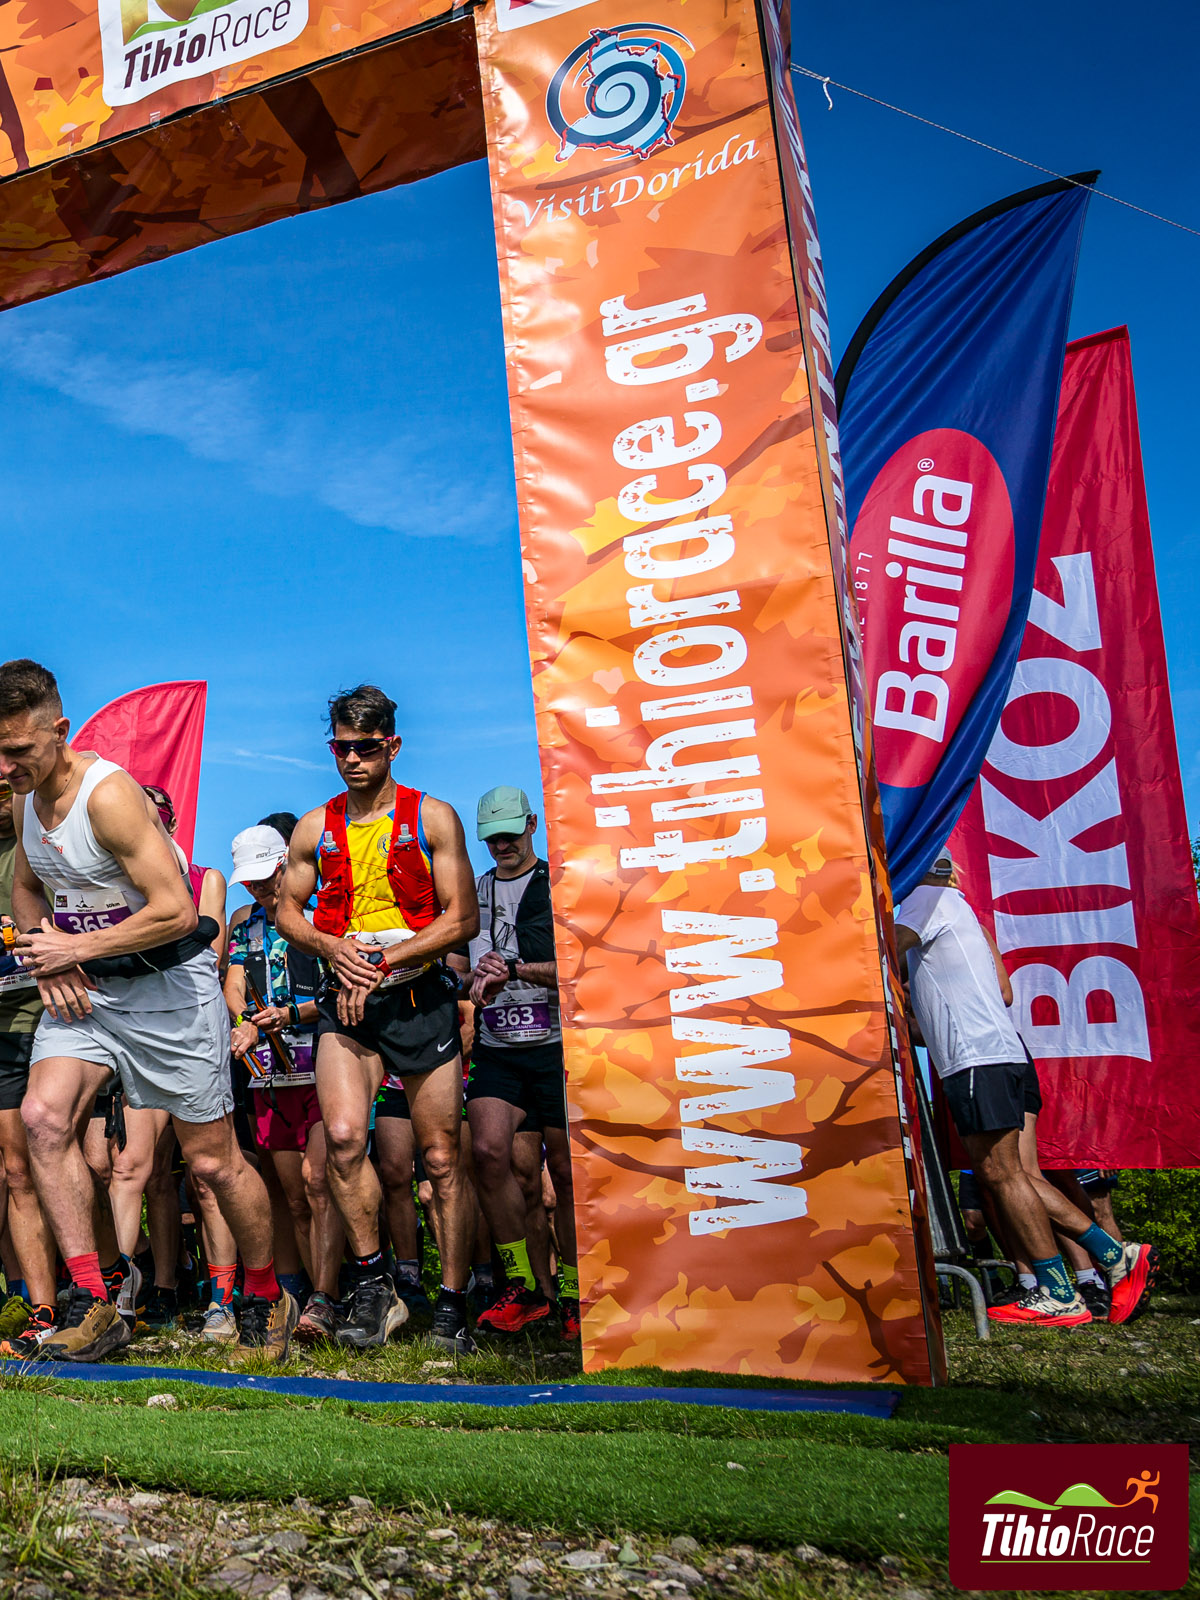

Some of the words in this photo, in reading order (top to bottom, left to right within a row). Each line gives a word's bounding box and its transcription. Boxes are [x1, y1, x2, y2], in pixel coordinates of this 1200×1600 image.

[123, 0, 292, 89] TihioRace
[506, 186, 605, 228] Visit
[609, 133, 760, 207] Dorida
[854, 551, 874, 602] 1877
[584, 290, 808, 1238] www.tihiorace.gr
[67, 913, 115, 934] 365
[494, 1005, 535, 1028] 363
